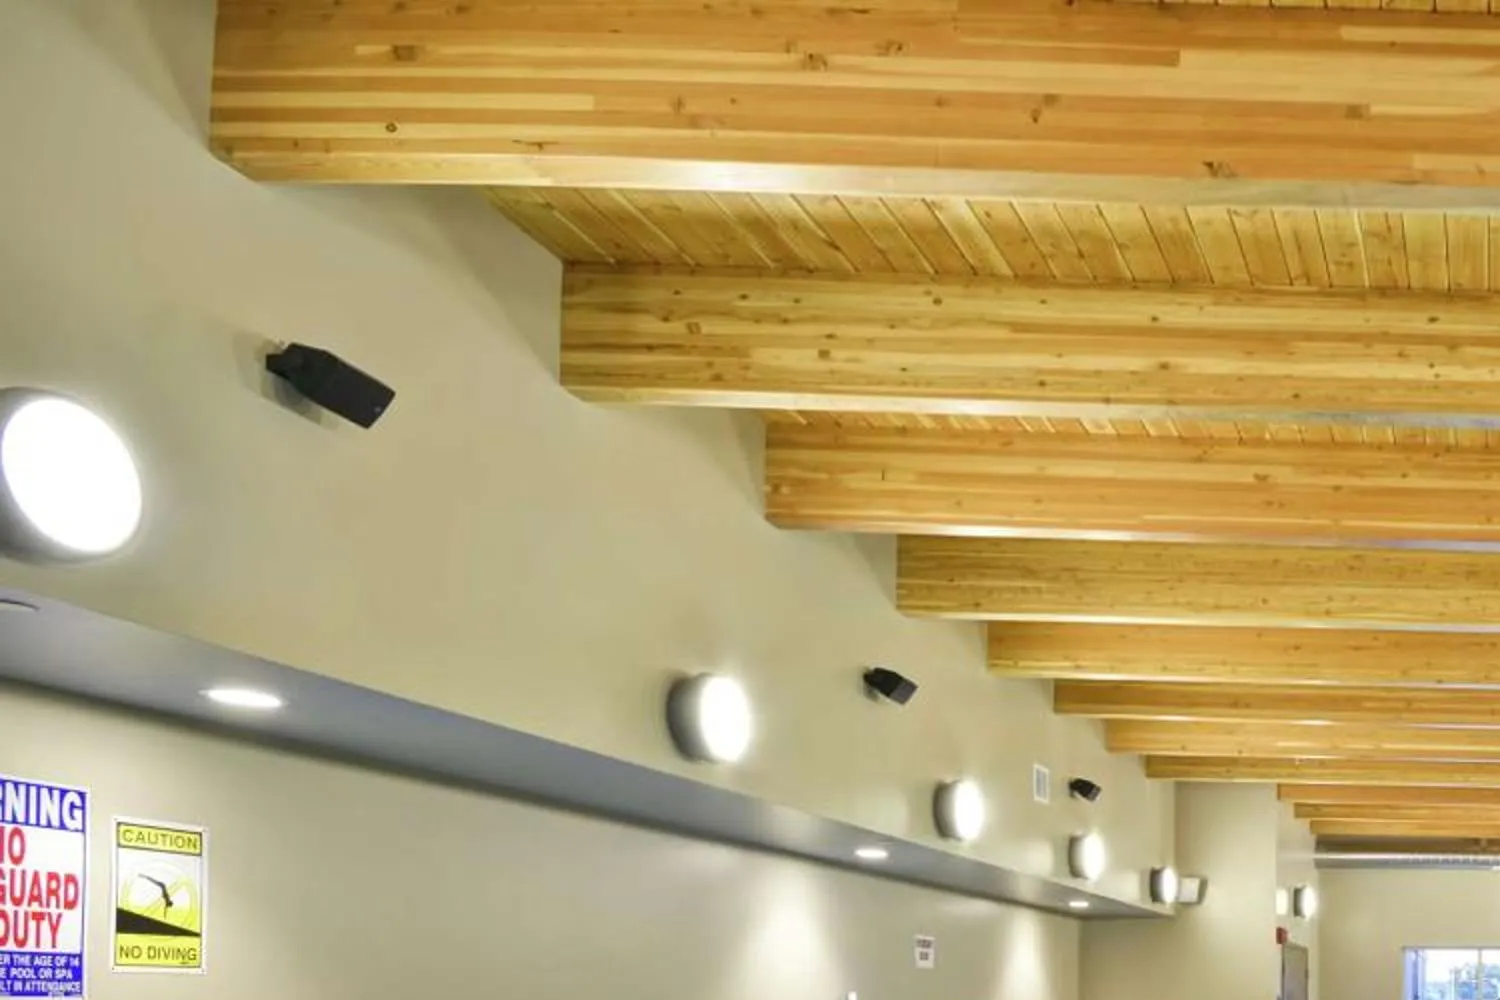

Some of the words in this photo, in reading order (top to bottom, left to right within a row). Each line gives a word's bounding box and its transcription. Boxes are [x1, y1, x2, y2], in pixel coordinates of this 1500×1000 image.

[0, 781, 84, 831] NING
[0, 825, 26, 866] O
[122, 828, 198, 850] CAUTION
[0, 909, 63, 948] DUTY
[13, 954, 32, 967] THE
[34, 955, 53, 967] AGE
[54, 956, 68, 967] OF
[119, 944, 143, 959] NO
[147, 945, 197, 961] DIVING
[10, 967, 36, 979] POOL
[39, 968, 53, 980] OR
[55, 968, 73, 980] SPA
[13, 980, 23, 992] IN
